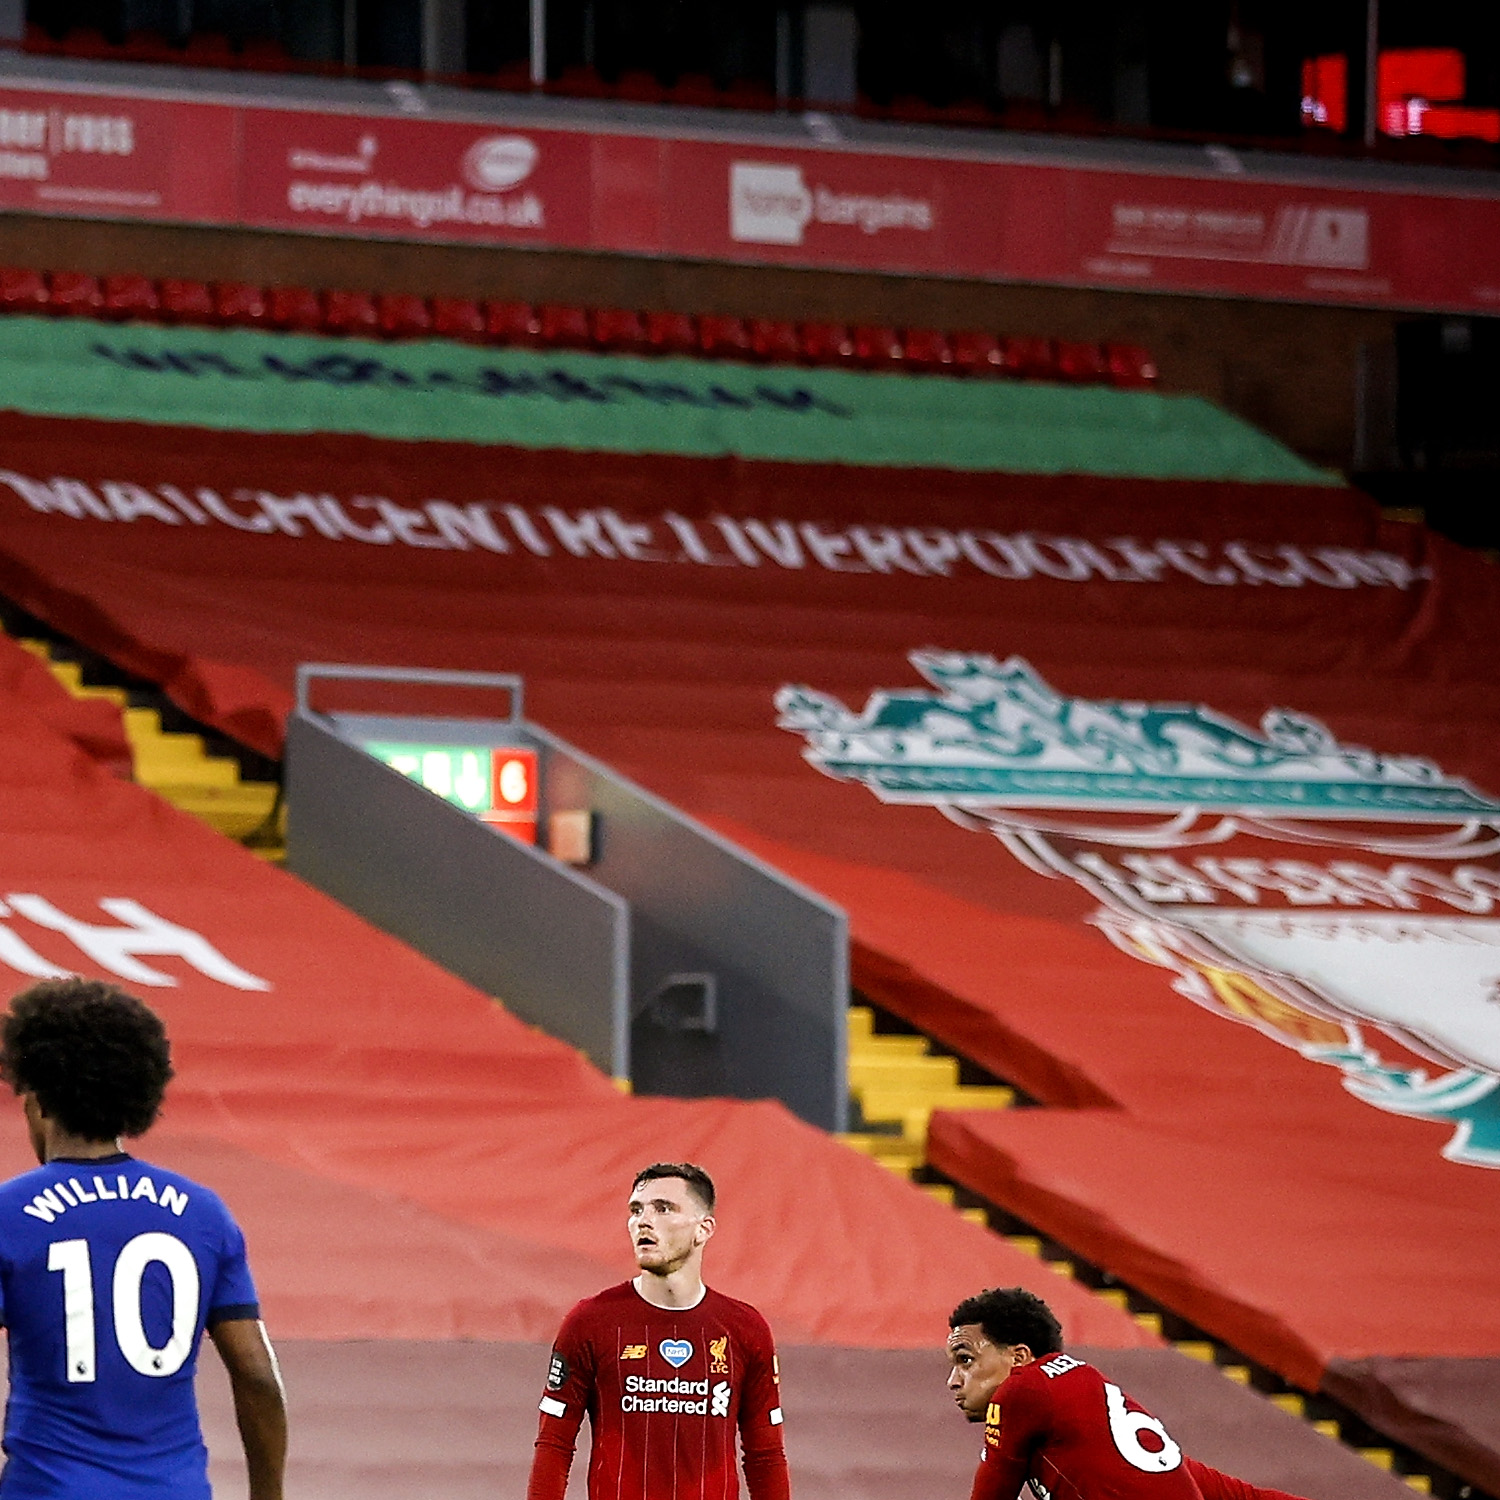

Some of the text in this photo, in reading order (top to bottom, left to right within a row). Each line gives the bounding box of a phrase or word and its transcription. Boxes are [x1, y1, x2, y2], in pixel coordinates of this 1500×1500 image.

[23, 1174, 189, 1223] WILLIAN
[47, 1231, 200, 1383] 10
[1039, 1353, 1087, 1379] ALEX
[625, 1375, 710, 1396] Standard
[620, 1395, 709, 1416] Chartered
